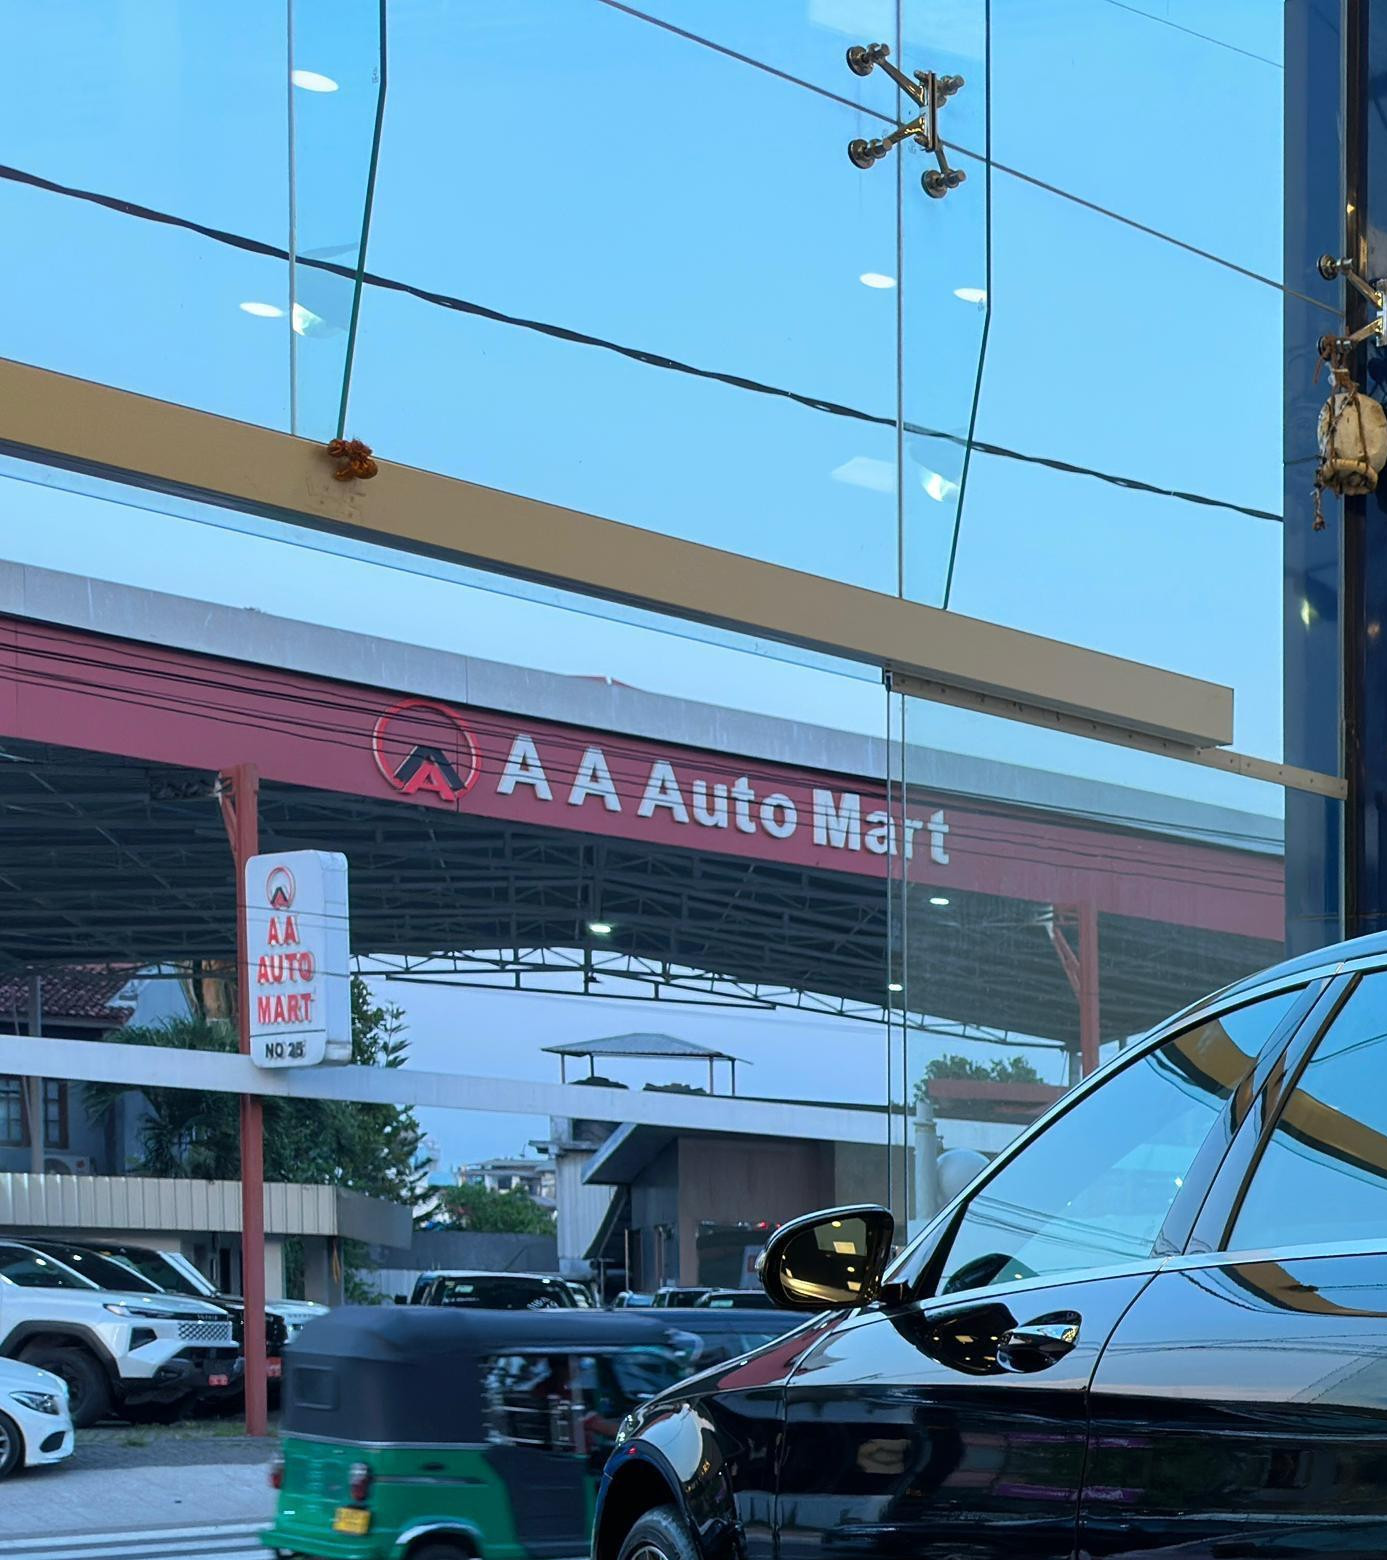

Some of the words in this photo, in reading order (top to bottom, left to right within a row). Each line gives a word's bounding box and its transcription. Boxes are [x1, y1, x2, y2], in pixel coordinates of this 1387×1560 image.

[496, 733, 553, 802] A
[567, 746, 622, 813] A
[637, 759, 798, 840] Auto
[812, 786, 950, 866] Mart
[257, 952, 314, 984] AUTO
[257, 993, 312, 1024] MART
[265, 1043, 284, 1059] NO
